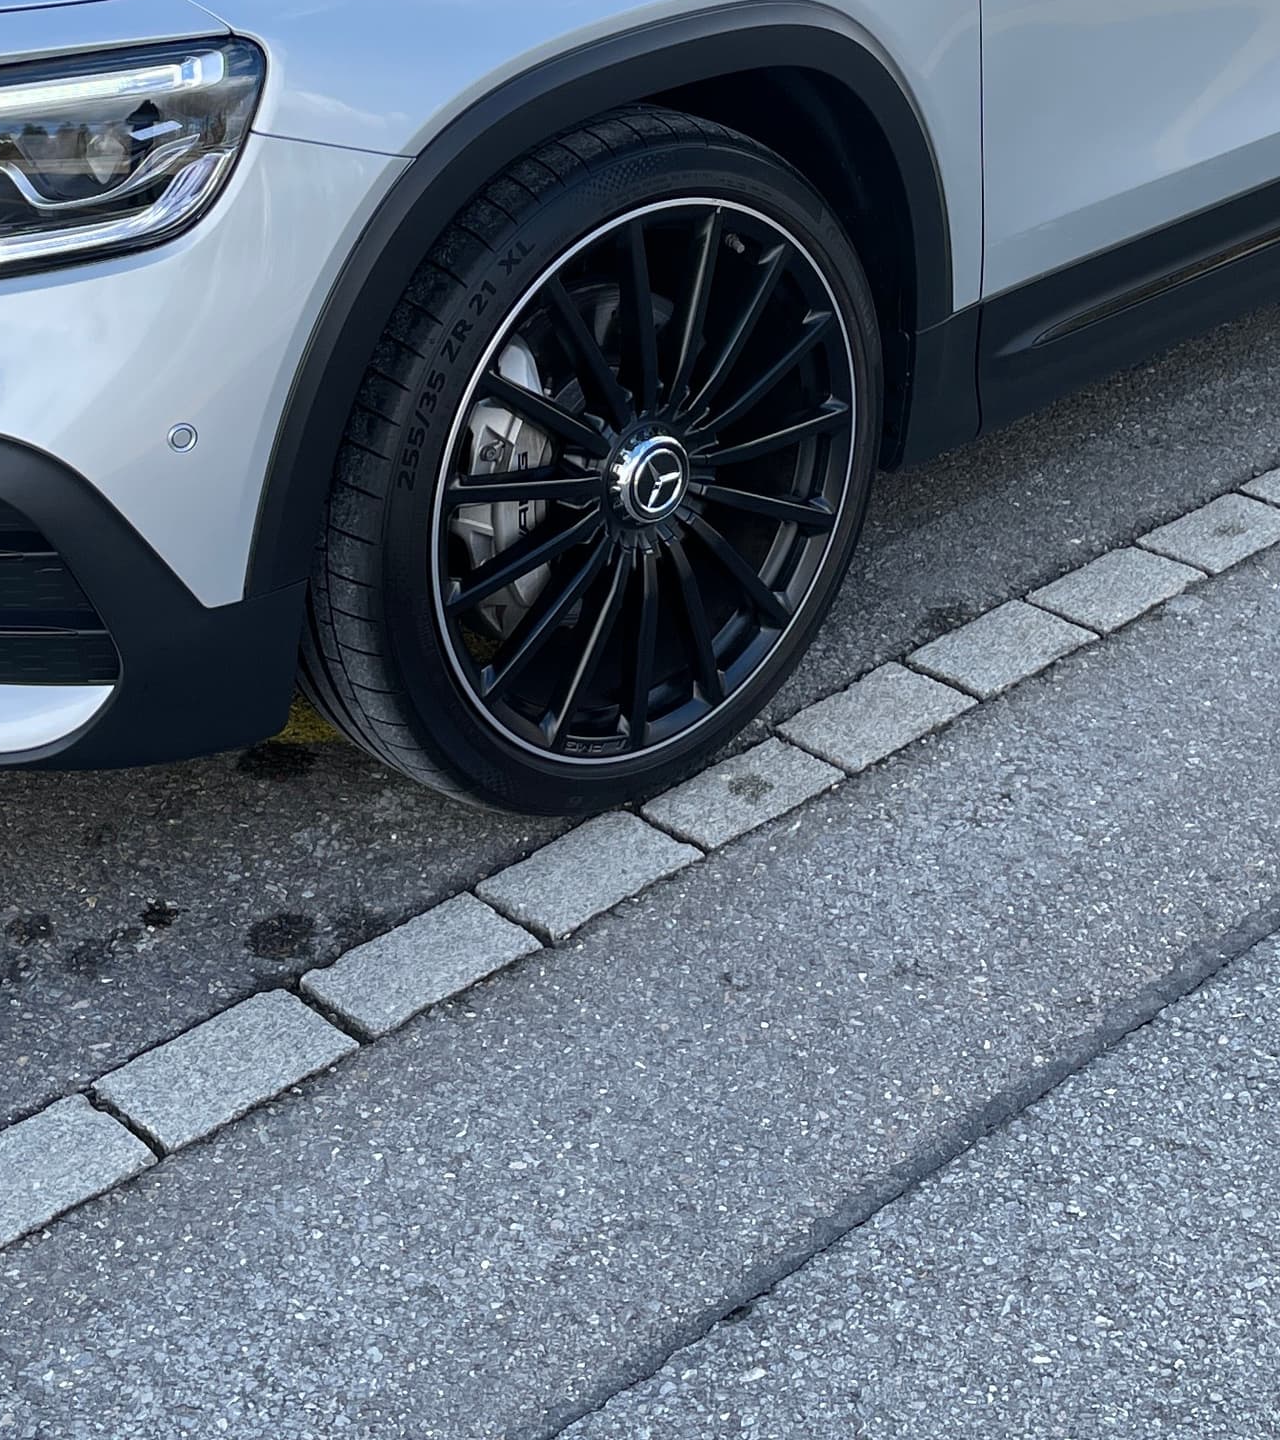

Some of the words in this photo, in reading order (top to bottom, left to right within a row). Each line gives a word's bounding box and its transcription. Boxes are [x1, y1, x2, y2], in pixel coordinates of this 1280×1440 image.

[440, 318, 474, 364] ZR
[468, 279, 498, 316] 21
[497, 241, 537, 277] XL
